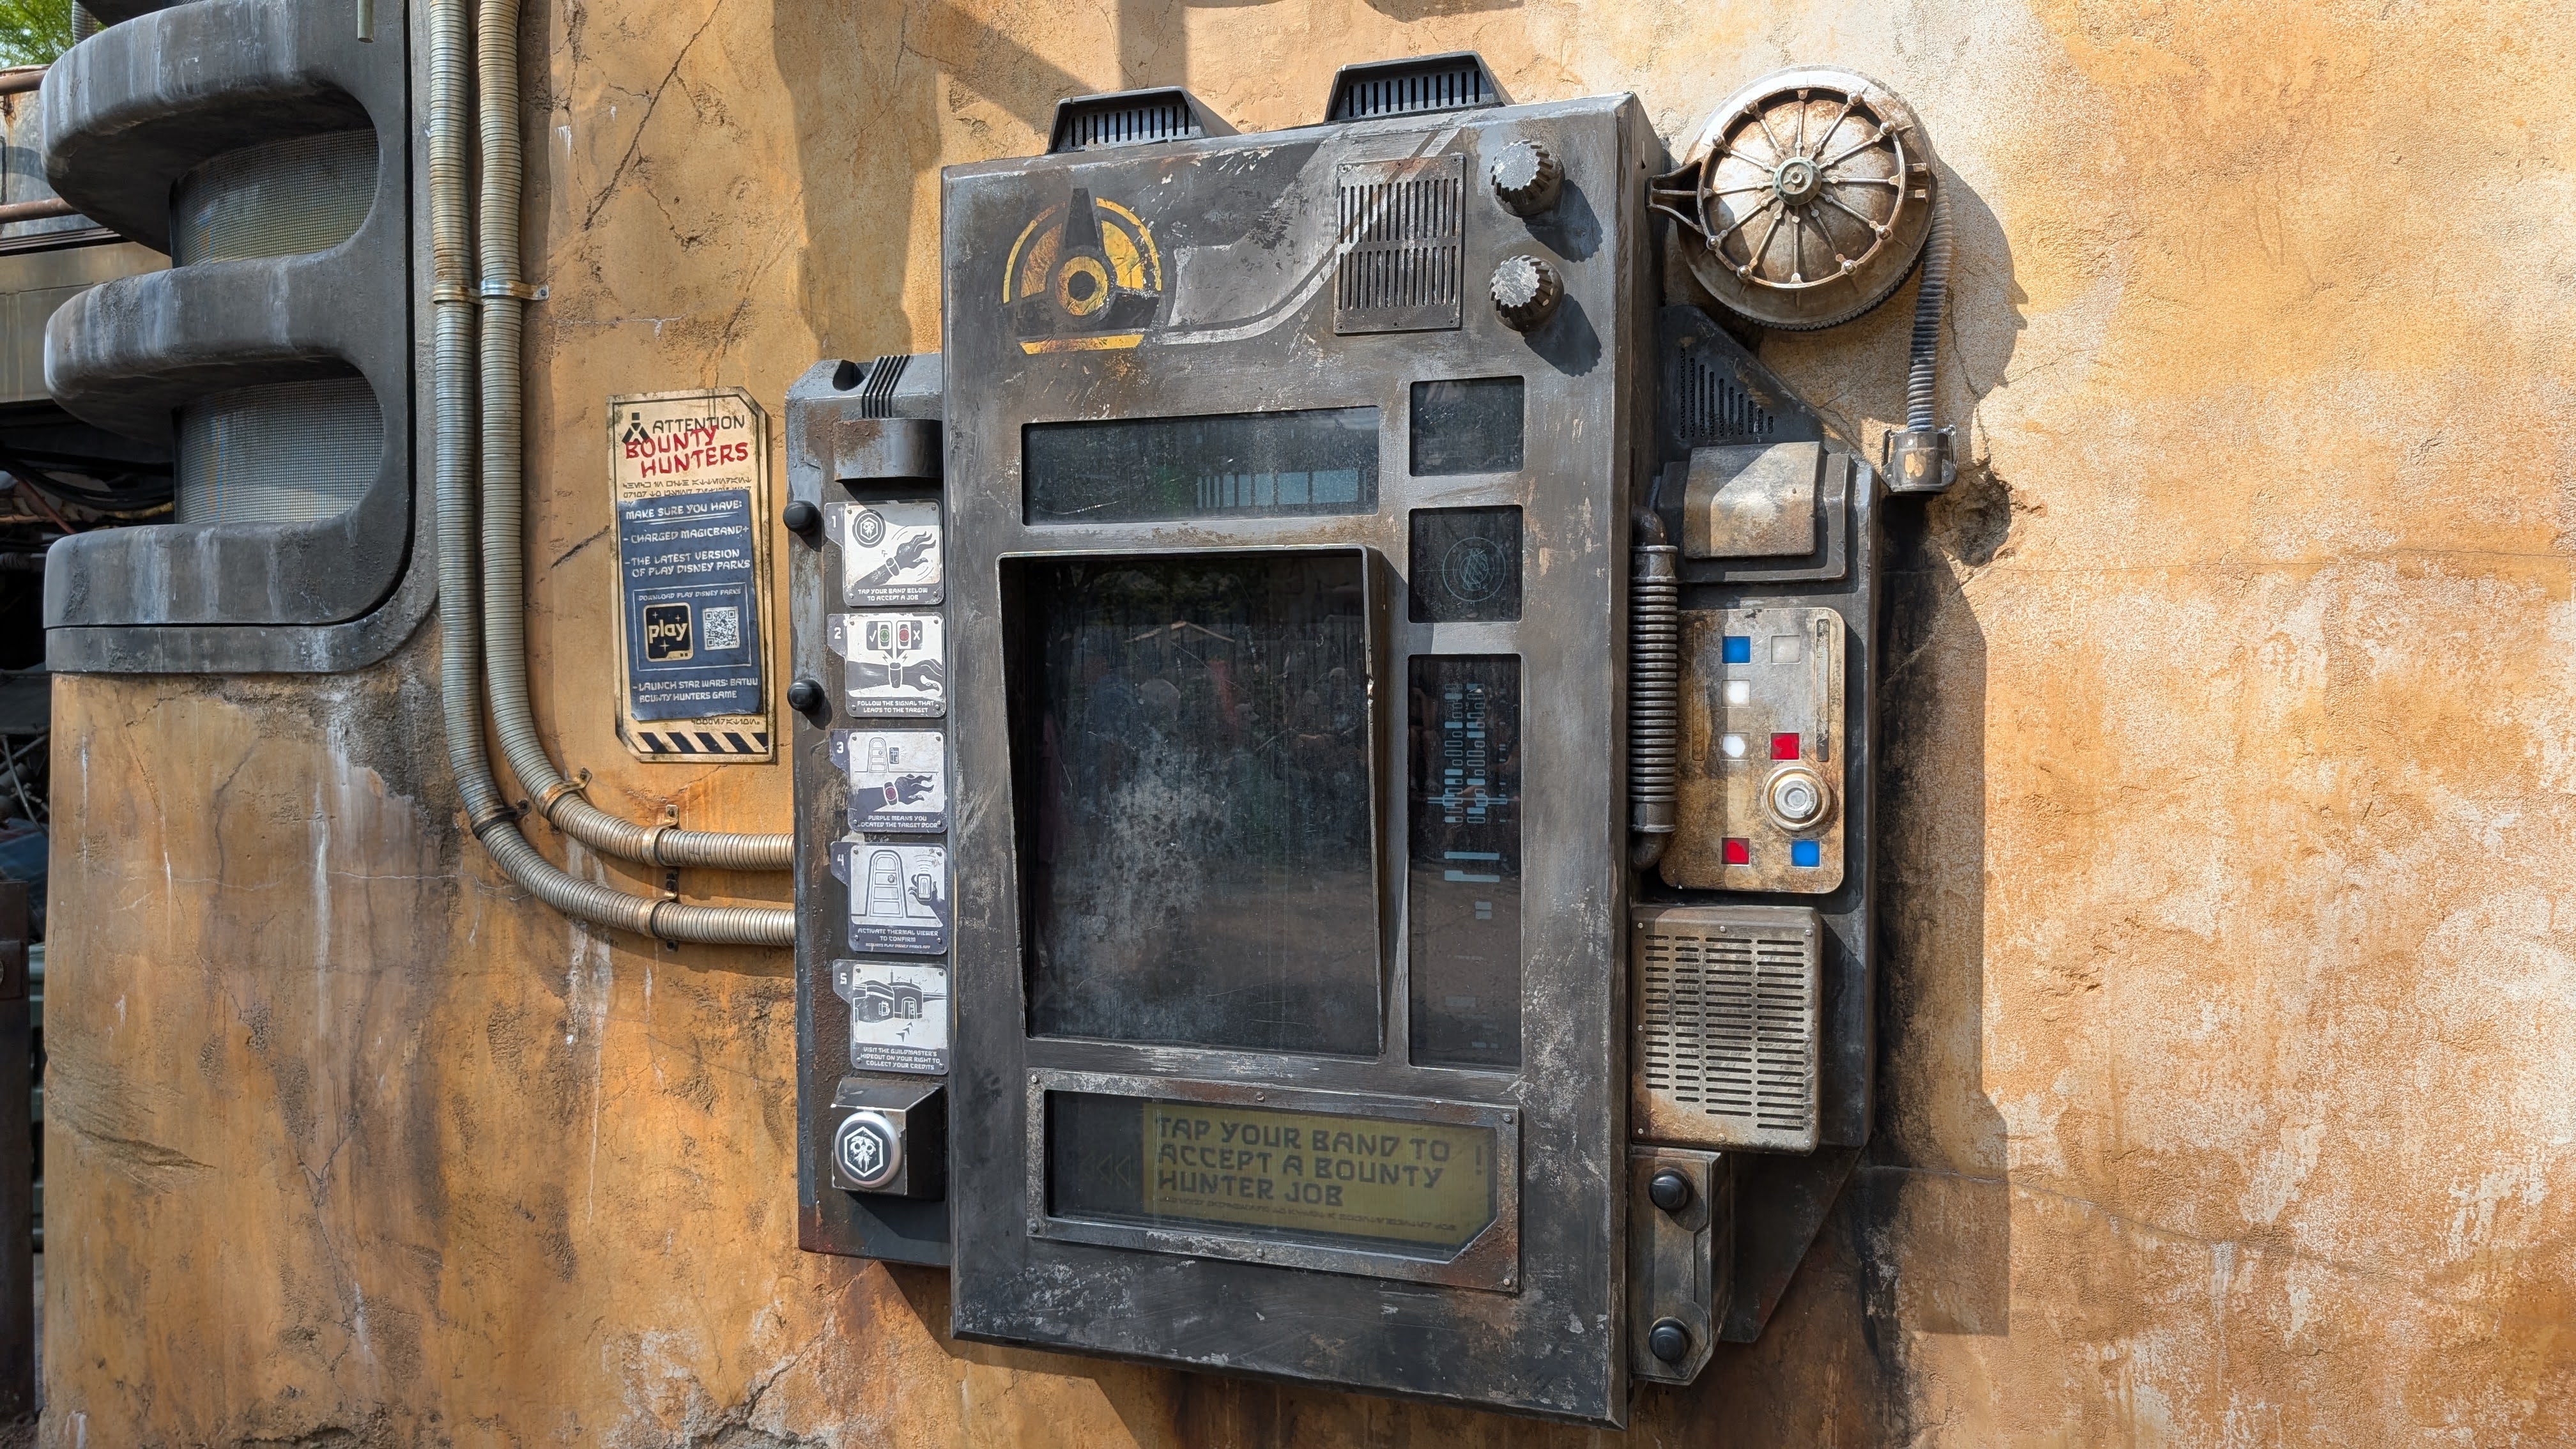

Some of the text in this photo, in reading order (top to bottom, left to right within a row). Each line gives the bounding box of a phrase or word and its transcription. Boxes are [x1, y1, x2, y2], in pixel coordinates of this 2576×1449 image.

[653, 415, 745, 433] ATTENTION
[626, 424, 719, 459] BOUNTY
[641, 442, 748, 478] HUNTERS
[626, 500, 742, 520] MAKE SURE YOU HAVE:
[832, 516, 836, 528] 1
[631, 531, 678, 543] CHARGED
[681, 525, 749, 539] MAGICBAND+
[631, 556, 650, 566] THE
[654, 552, 691, 564] LATEST
[695, 548, 740, 561] VERSION
[632, 560, 750, 578] OF PLAY DISNEY PARKS
[639, 593, 675, 601] DOWNLOAD
[648, 618, 687, 644] play
[834, 627, 841, 639] 2
[639, 681, 677, 691] LAUNCH
[679, 679, 700, 689] STAR
[702, 678, 728, 687] WARS:
[730, 677, 758, 686] BATUU
[640, 691, 737, 703] BOUNTY HUNTERS GAME
[837, 742, 843, 753] 3
[837, 854, 844, 866] 4
[840, 972, 847, 985] 5
[891, 1048, 937, 1057] GUILDMASTER'S
[1156, 1117, 1450, 1162] TAP YOUR BAND TO
[1158, 1144, 1443, 1188] ACCEPT A BOUNTY
[1158, 1170, 1343, 1206] HUNTER JOB
